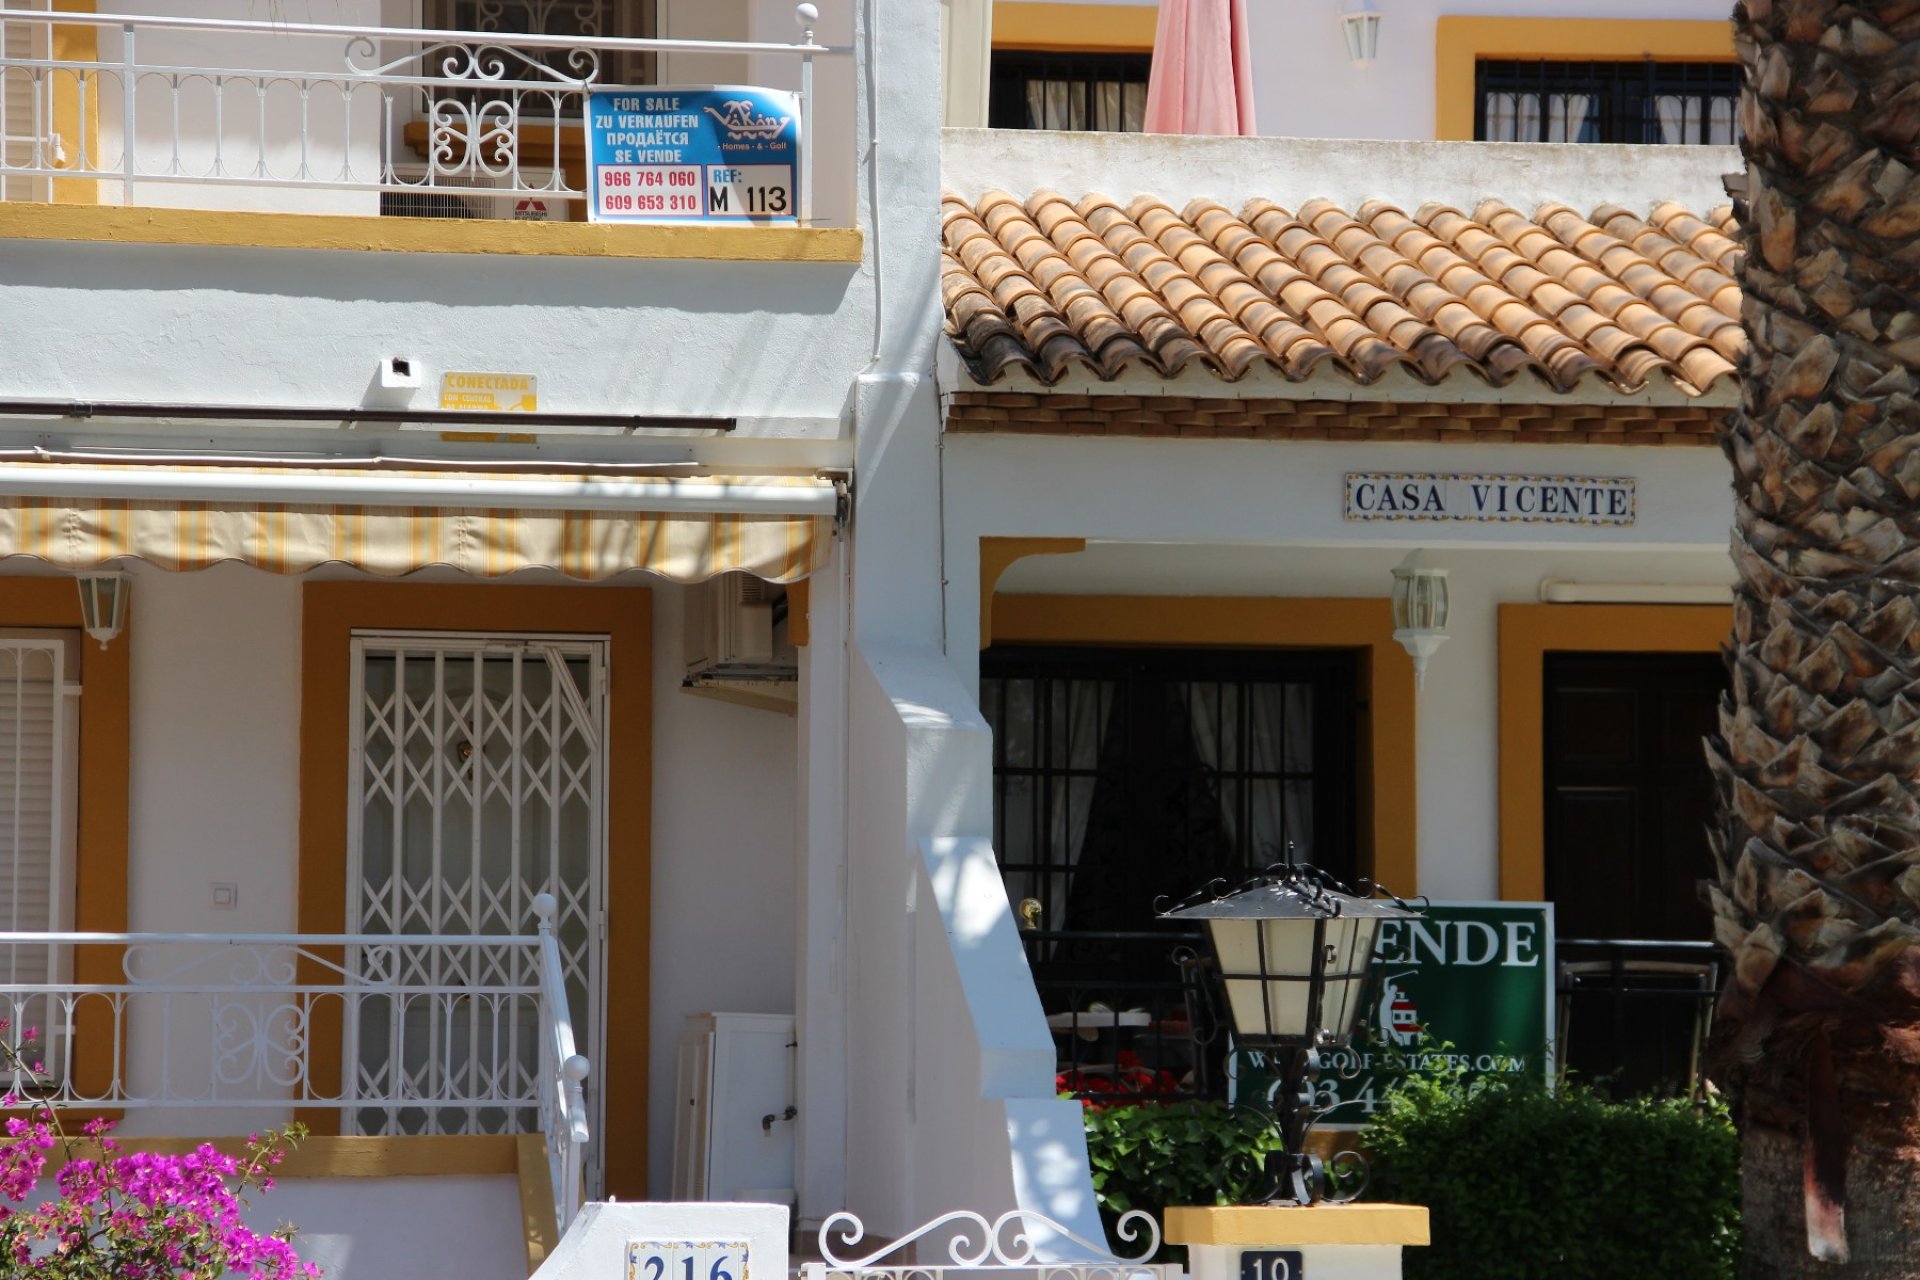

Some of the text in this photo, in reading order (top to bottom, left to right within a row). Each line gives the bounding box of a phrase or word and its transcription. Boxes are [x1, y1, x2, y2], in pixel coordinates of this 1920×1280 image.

[614, 98, 680, 111] FOR SALE
[595, 115, 698, 129] ZU VERKAUFEN
[607, 131, 689, 147] ПРОДАЁТСЯ
[722, 142, 750, 151] Homes
[769, 141, 787, 150] Golf
[615, 149, 682, 164] SE VENDE
[604, 171, 695, 187] 966 764 060
[713, 168, 742, 184] REF:
[605, 194, 696, 211] 609 653 310
[709, 186, 787, 212] M 113
[447, 375, 529, 391] CONECTADA
[1356, 483, 1628, 516] CASA VICENTE
[1372, 919, 1539, 967] ENDE
[644, 1256, 733, 1280] 216
[1253, 1258, 1290, 1280] 10
